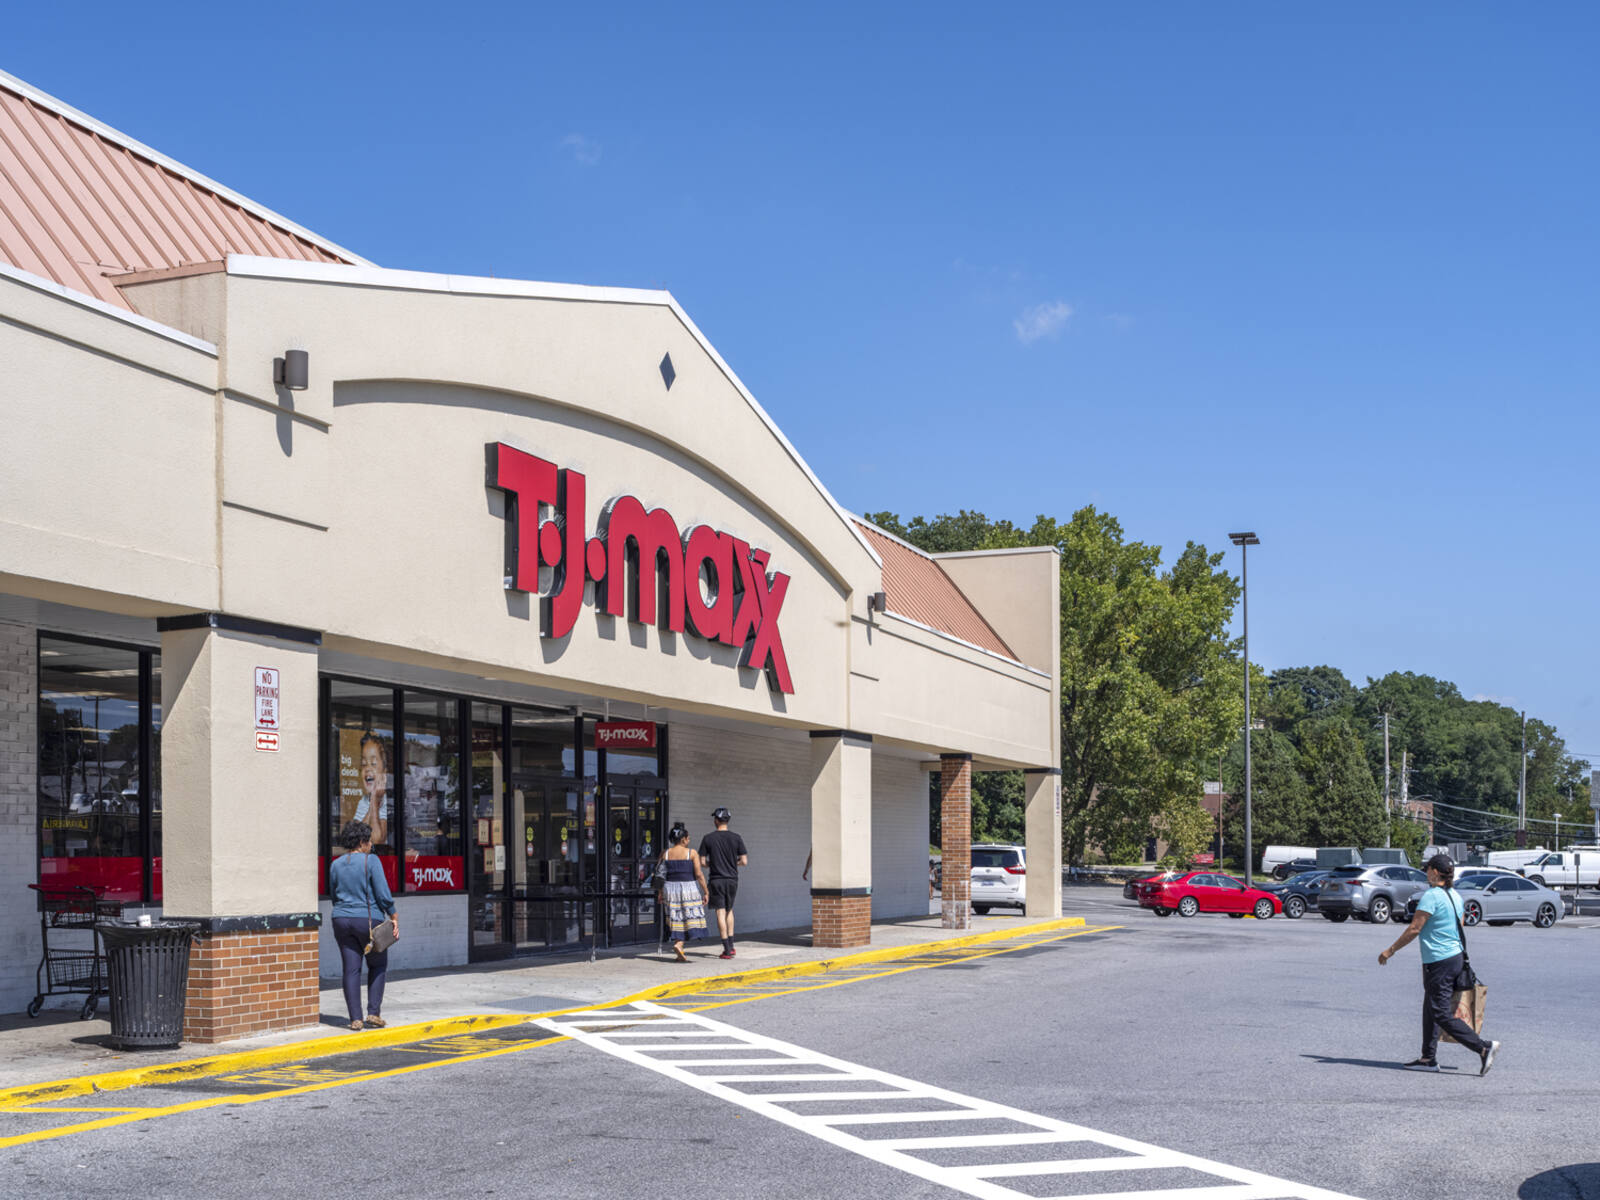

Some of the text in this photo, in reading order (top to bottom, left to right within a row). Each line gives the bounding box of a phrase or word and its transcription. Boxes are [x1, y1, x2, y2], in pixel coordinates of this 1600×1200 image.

[262, 673, 272, 684] NO
[256, 686, 279, 699] PARKING
[261, 699, 273, 708] FIRE
[261, 709, 273, 717] LANE
[341, 754, 352, 767] big
[341, 767, 359, 777] deals
[342, 788, 363, 796] savers
